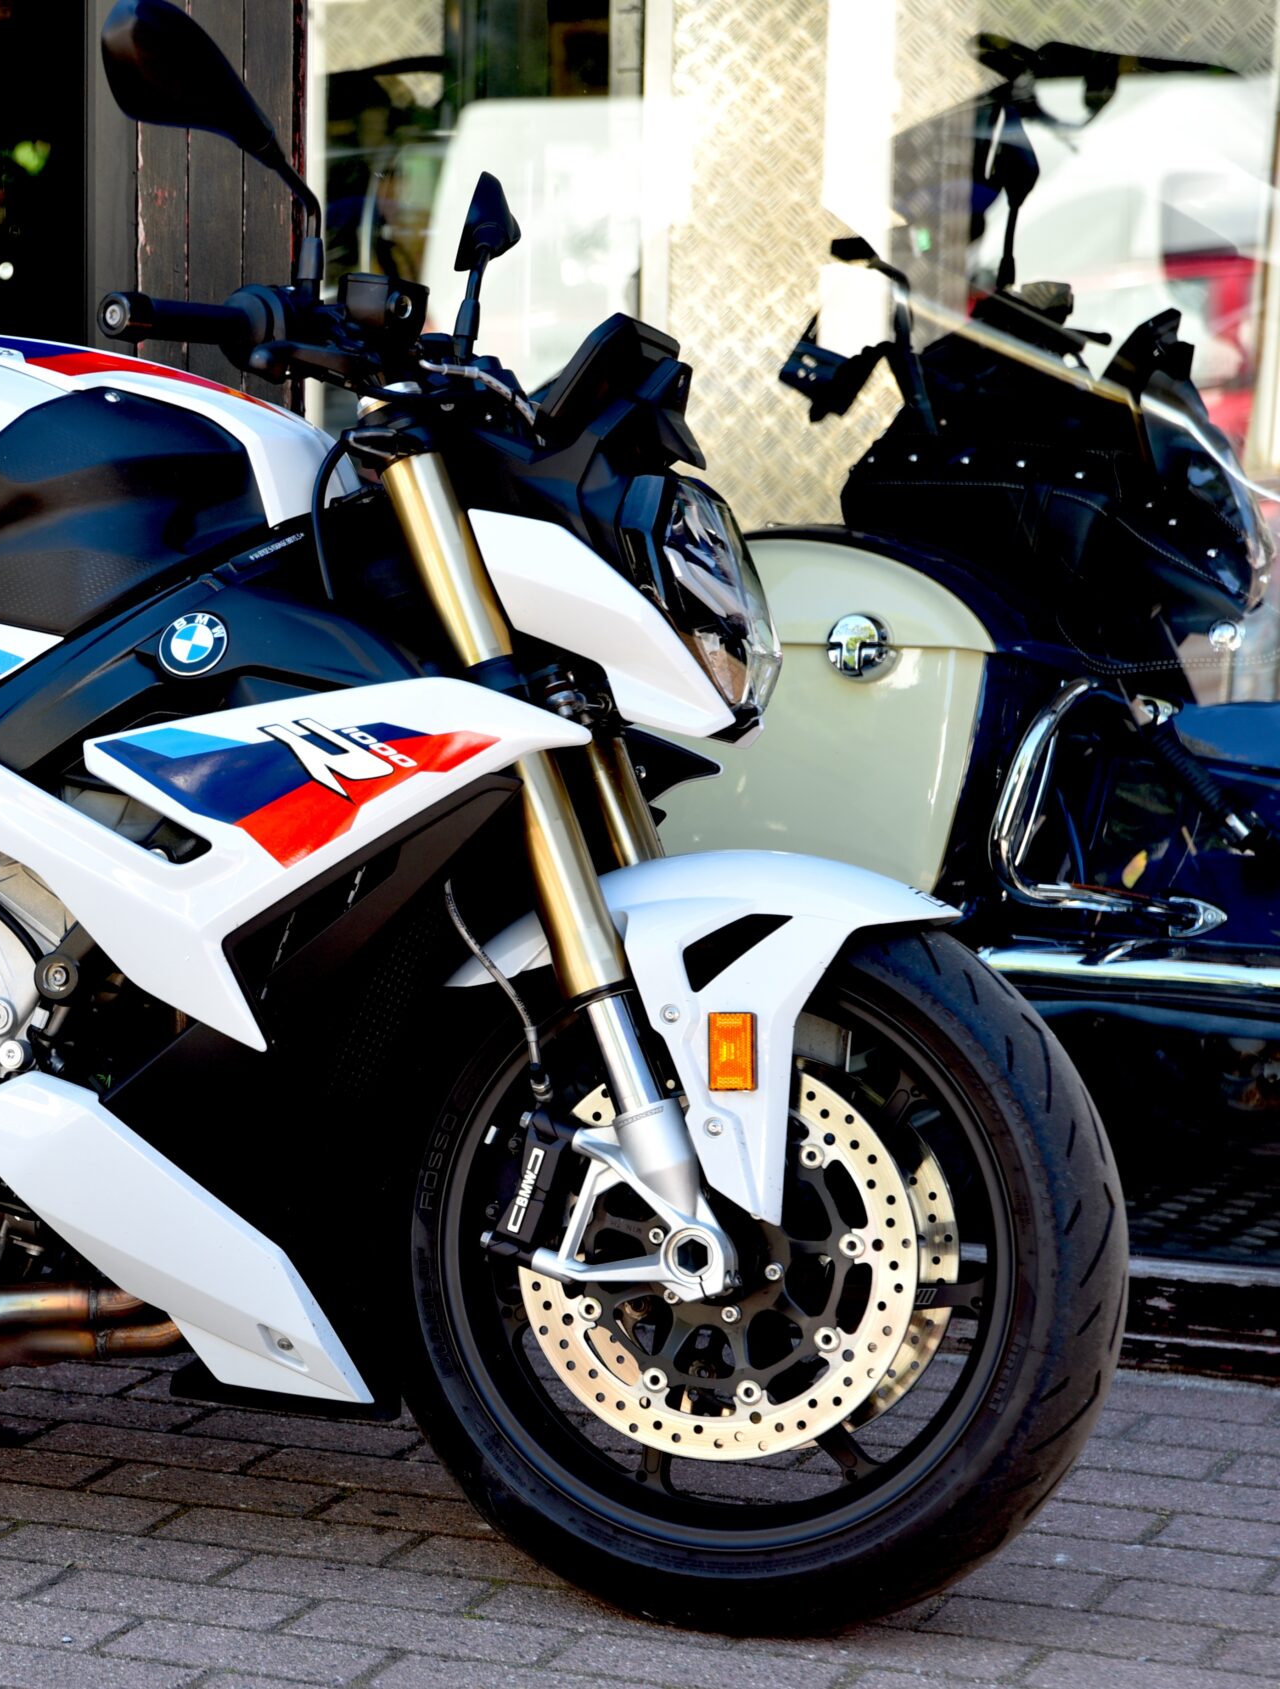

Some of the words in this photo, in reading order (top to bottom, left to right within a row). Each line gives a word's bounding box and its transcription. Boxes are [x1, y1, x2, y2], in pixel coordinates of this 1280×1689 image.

[173, 614, 225, 638] BMW
[420, 1113, 458, 1210] ROSSO
[515, 1169, 537, 1208] BMW
